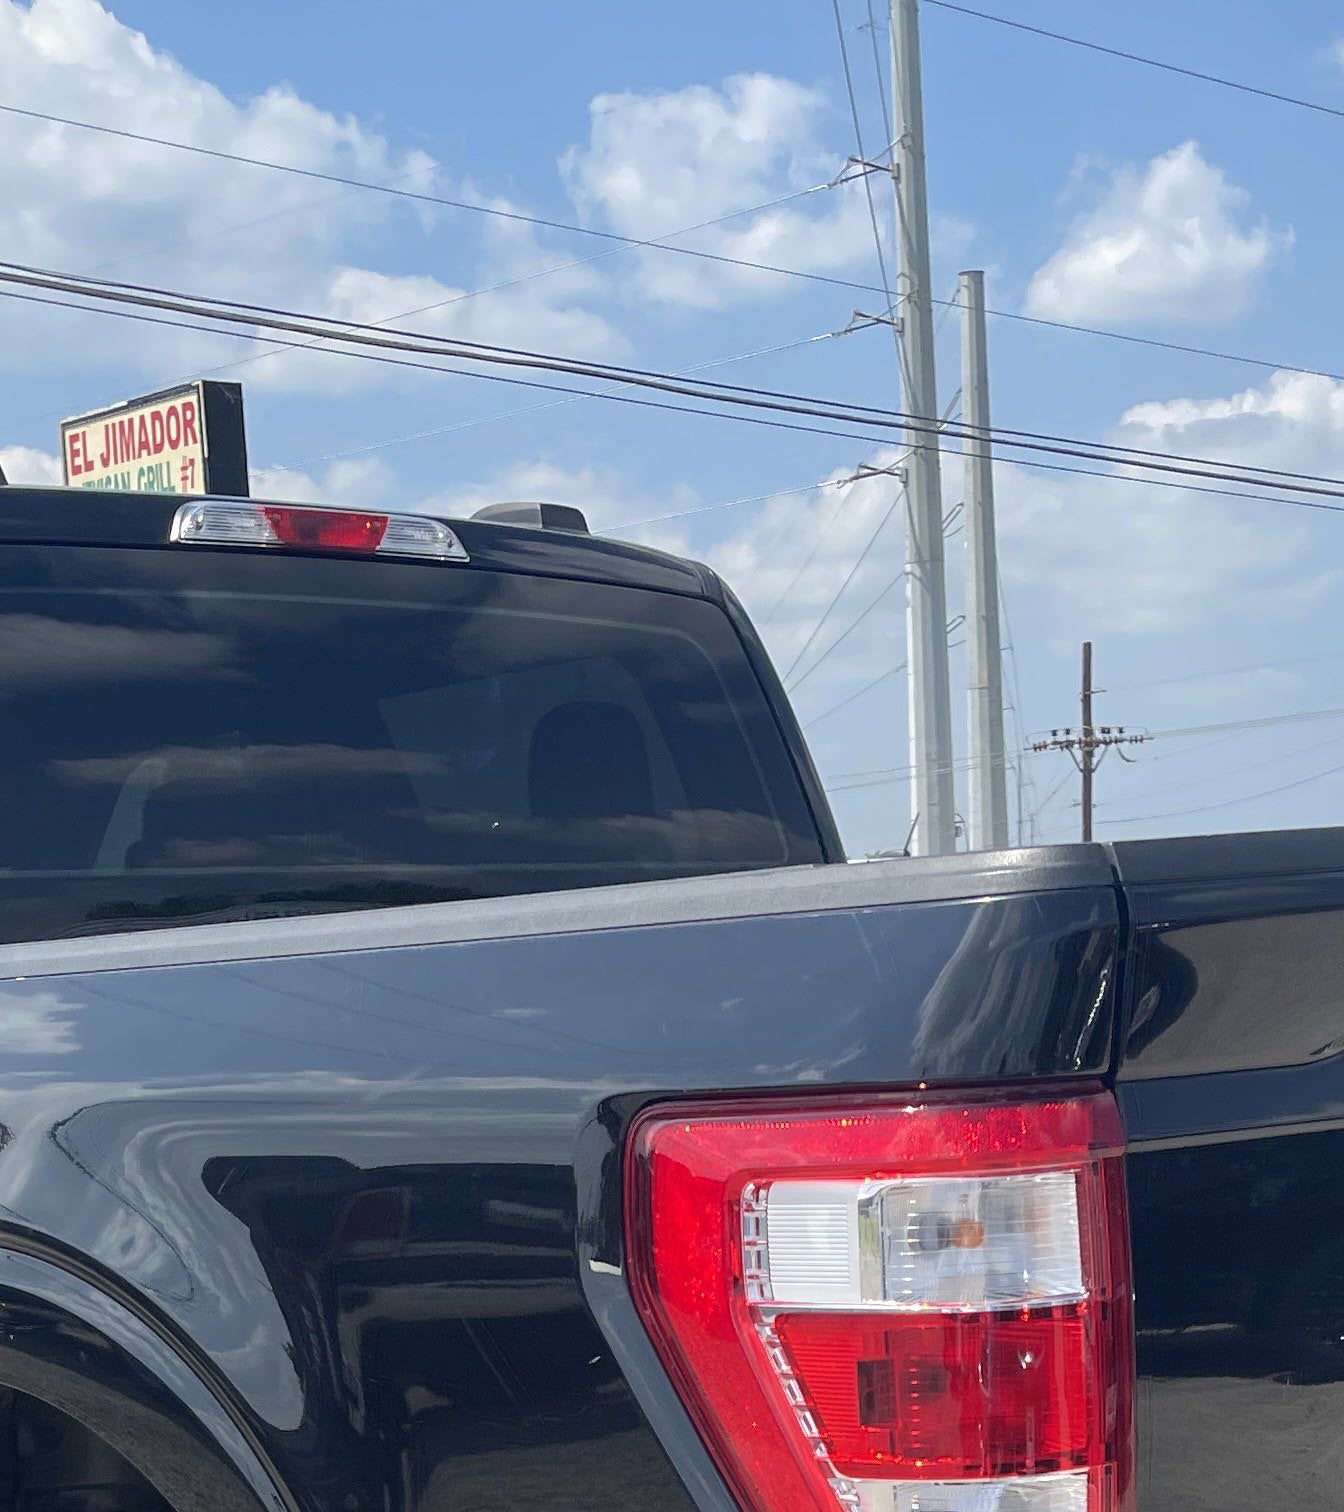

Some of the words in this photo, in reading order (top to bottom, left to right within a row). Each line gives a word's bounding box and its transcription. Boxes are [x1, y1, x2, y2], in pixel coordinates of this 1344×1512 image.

[68, 430, 94, 476] EL
[100, 401, 198, 469] JIMADOR
[137, 461, 176, 492] GRILL
[180, 455, 196, 493] #7
